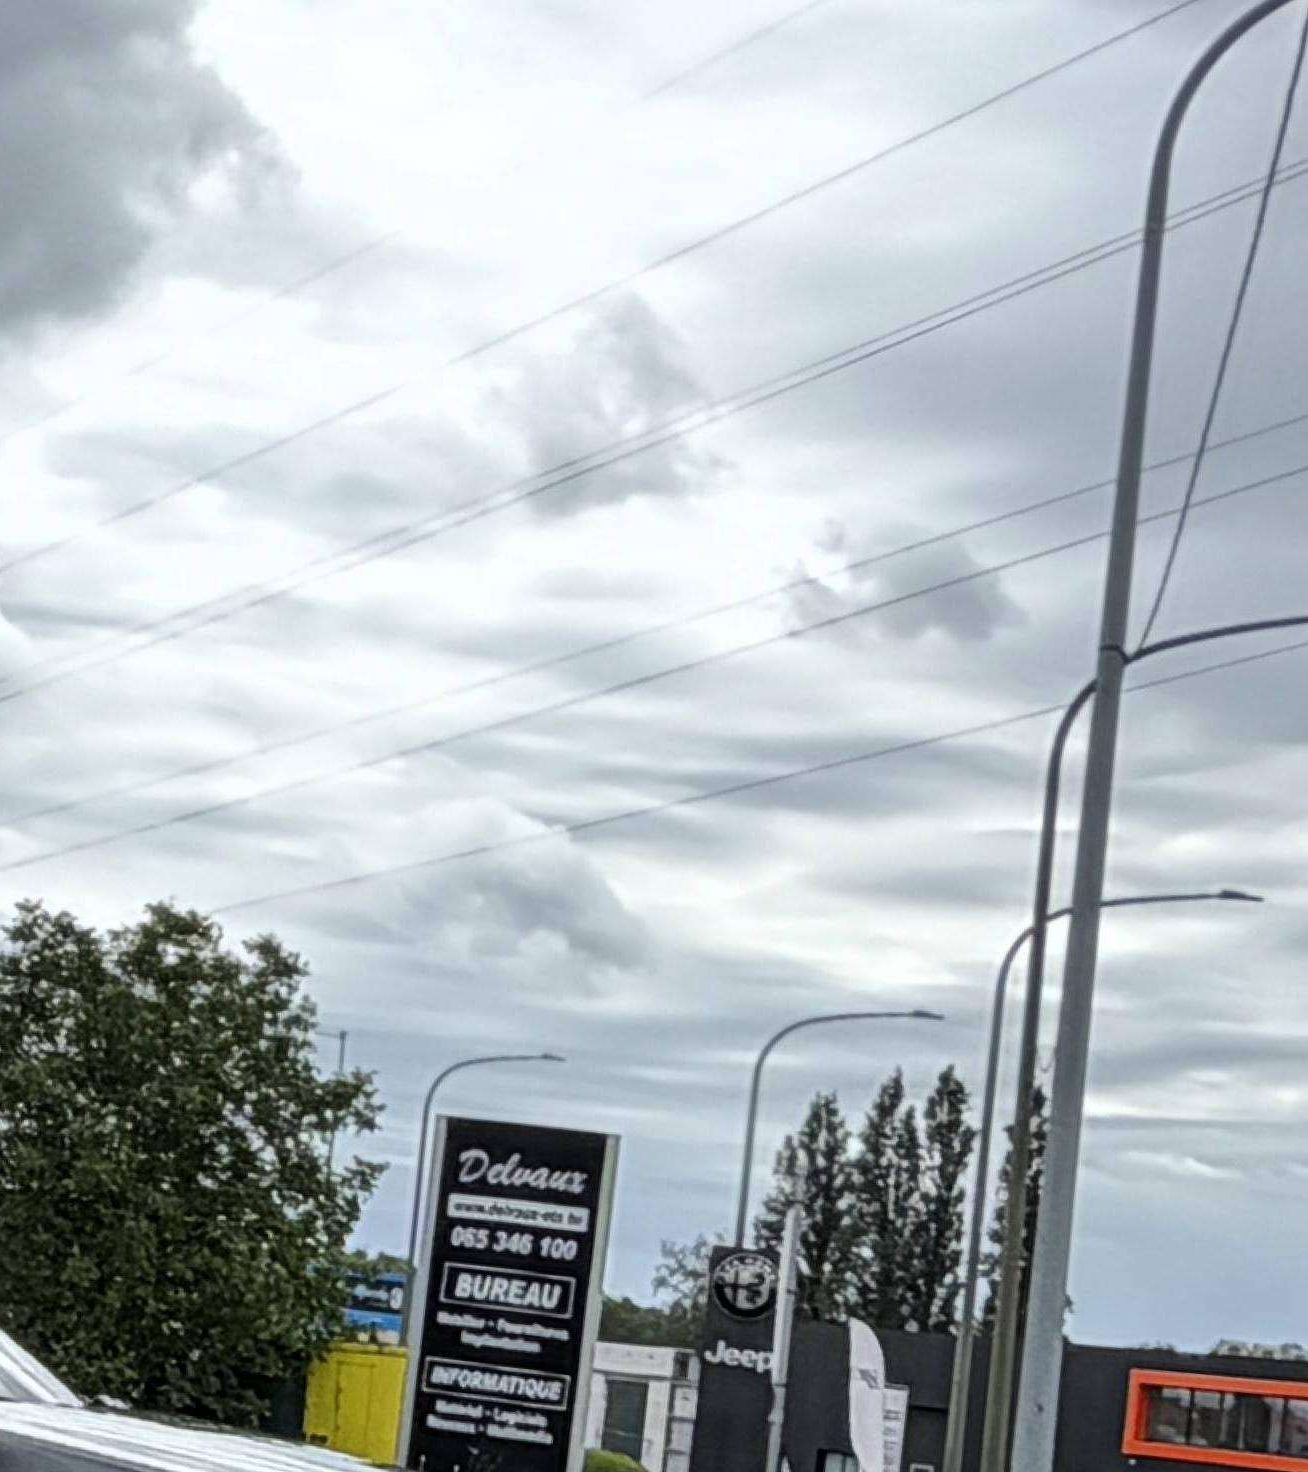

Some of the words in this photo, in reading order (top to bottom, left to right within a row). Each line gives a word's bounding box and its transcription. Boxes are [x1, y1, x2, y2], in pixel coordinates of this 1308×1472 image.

[458, 1148, 589, 1194] Delvaux
[450, 1225, 489, 1249] 065
[493, 1231, 534, 1255] 346
[540, 1236, 578, 1260] 100
[454, 1272, 563, 1309] BUREAU
[704, 1339, 774, 1374] Jeep
[430, 1366, 563, 1401] INFORMATIQUE
